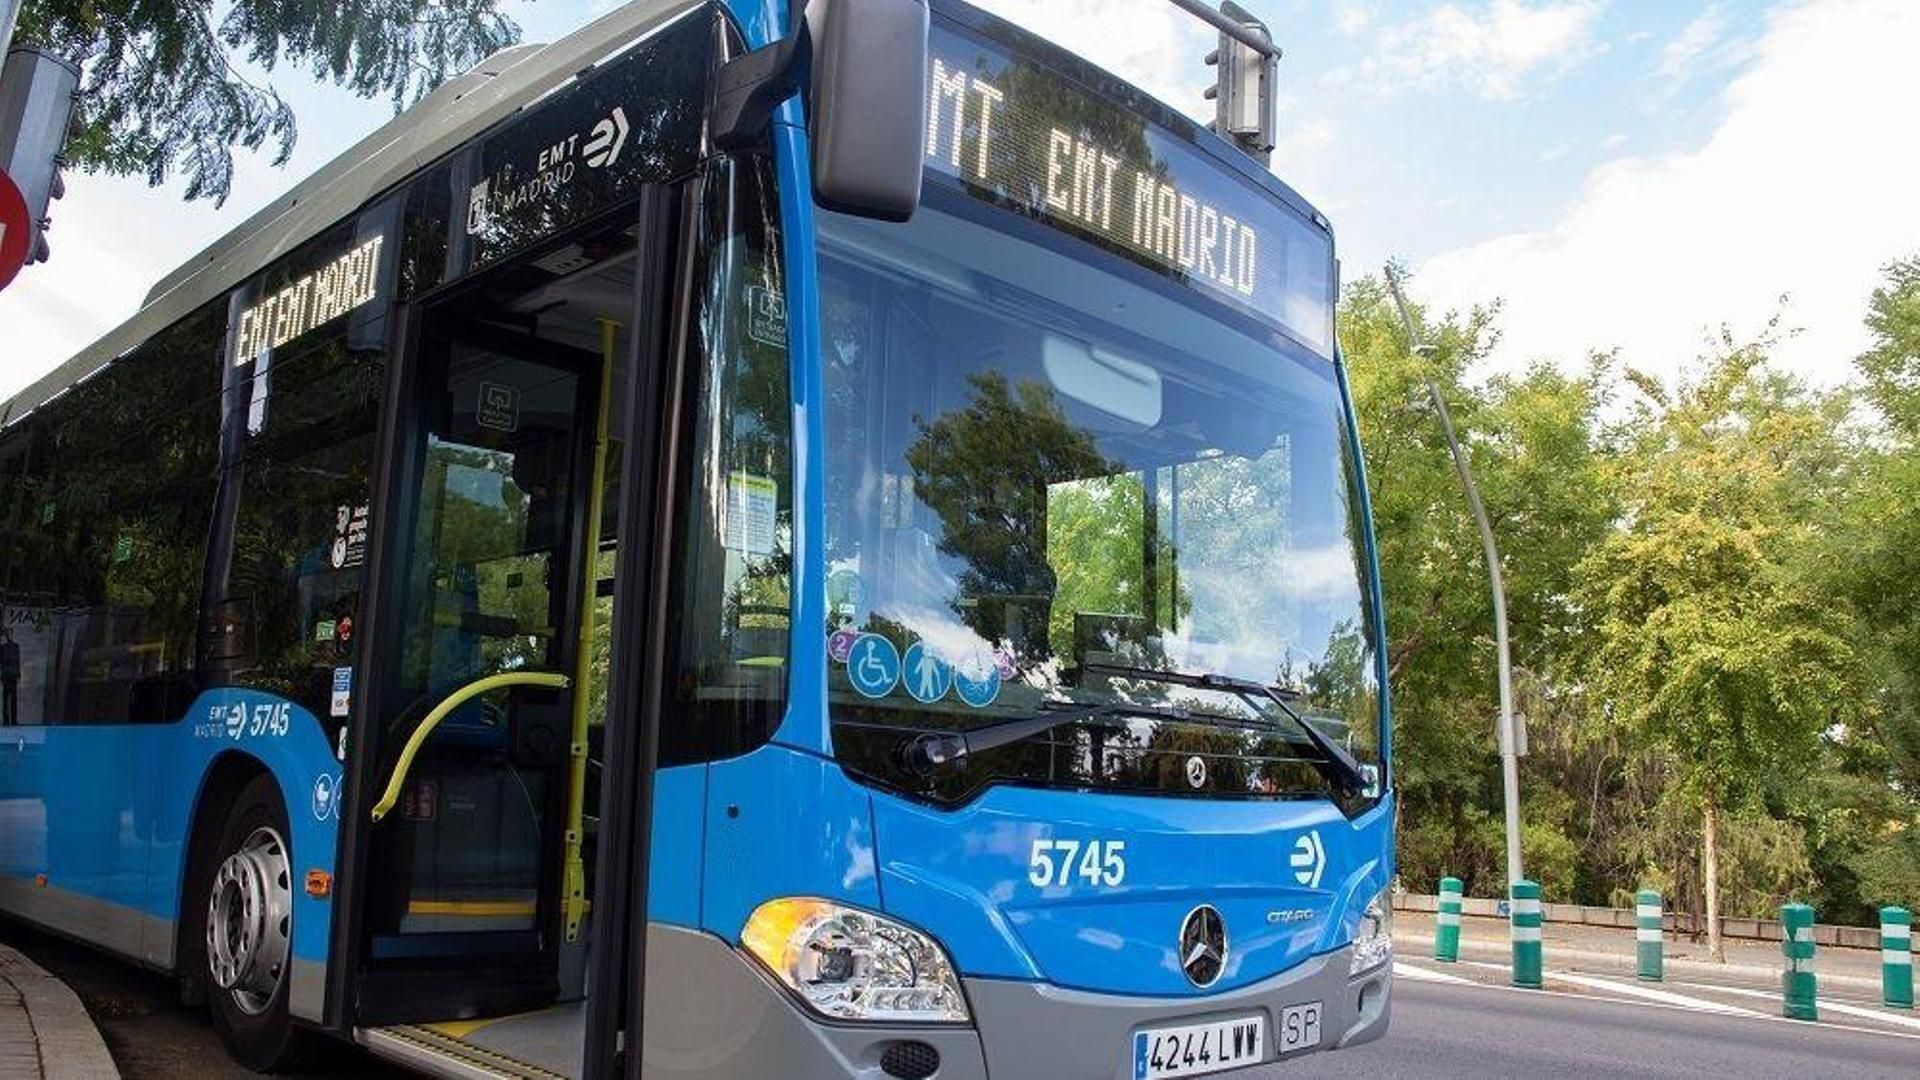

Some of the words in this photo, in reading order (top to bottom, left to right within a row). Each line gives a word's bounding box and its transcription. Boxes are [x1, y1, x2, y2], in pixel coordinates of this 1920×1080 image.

[538, 133, 579, 173] EMT
[503, 161, 575, 213] MADRID
[1046, 128, 1119, 230] EMT
[1132, 171, 1257, 296] MADRID
[251, 703, 291, 736] 5745
[1029, 840, 1125, 887] 5745
[1151, 1030, 1211, 1071] 4244
[1219, 1023, 1258, 1061] LWW
[1286, 1008, 1317, 1045] SP
